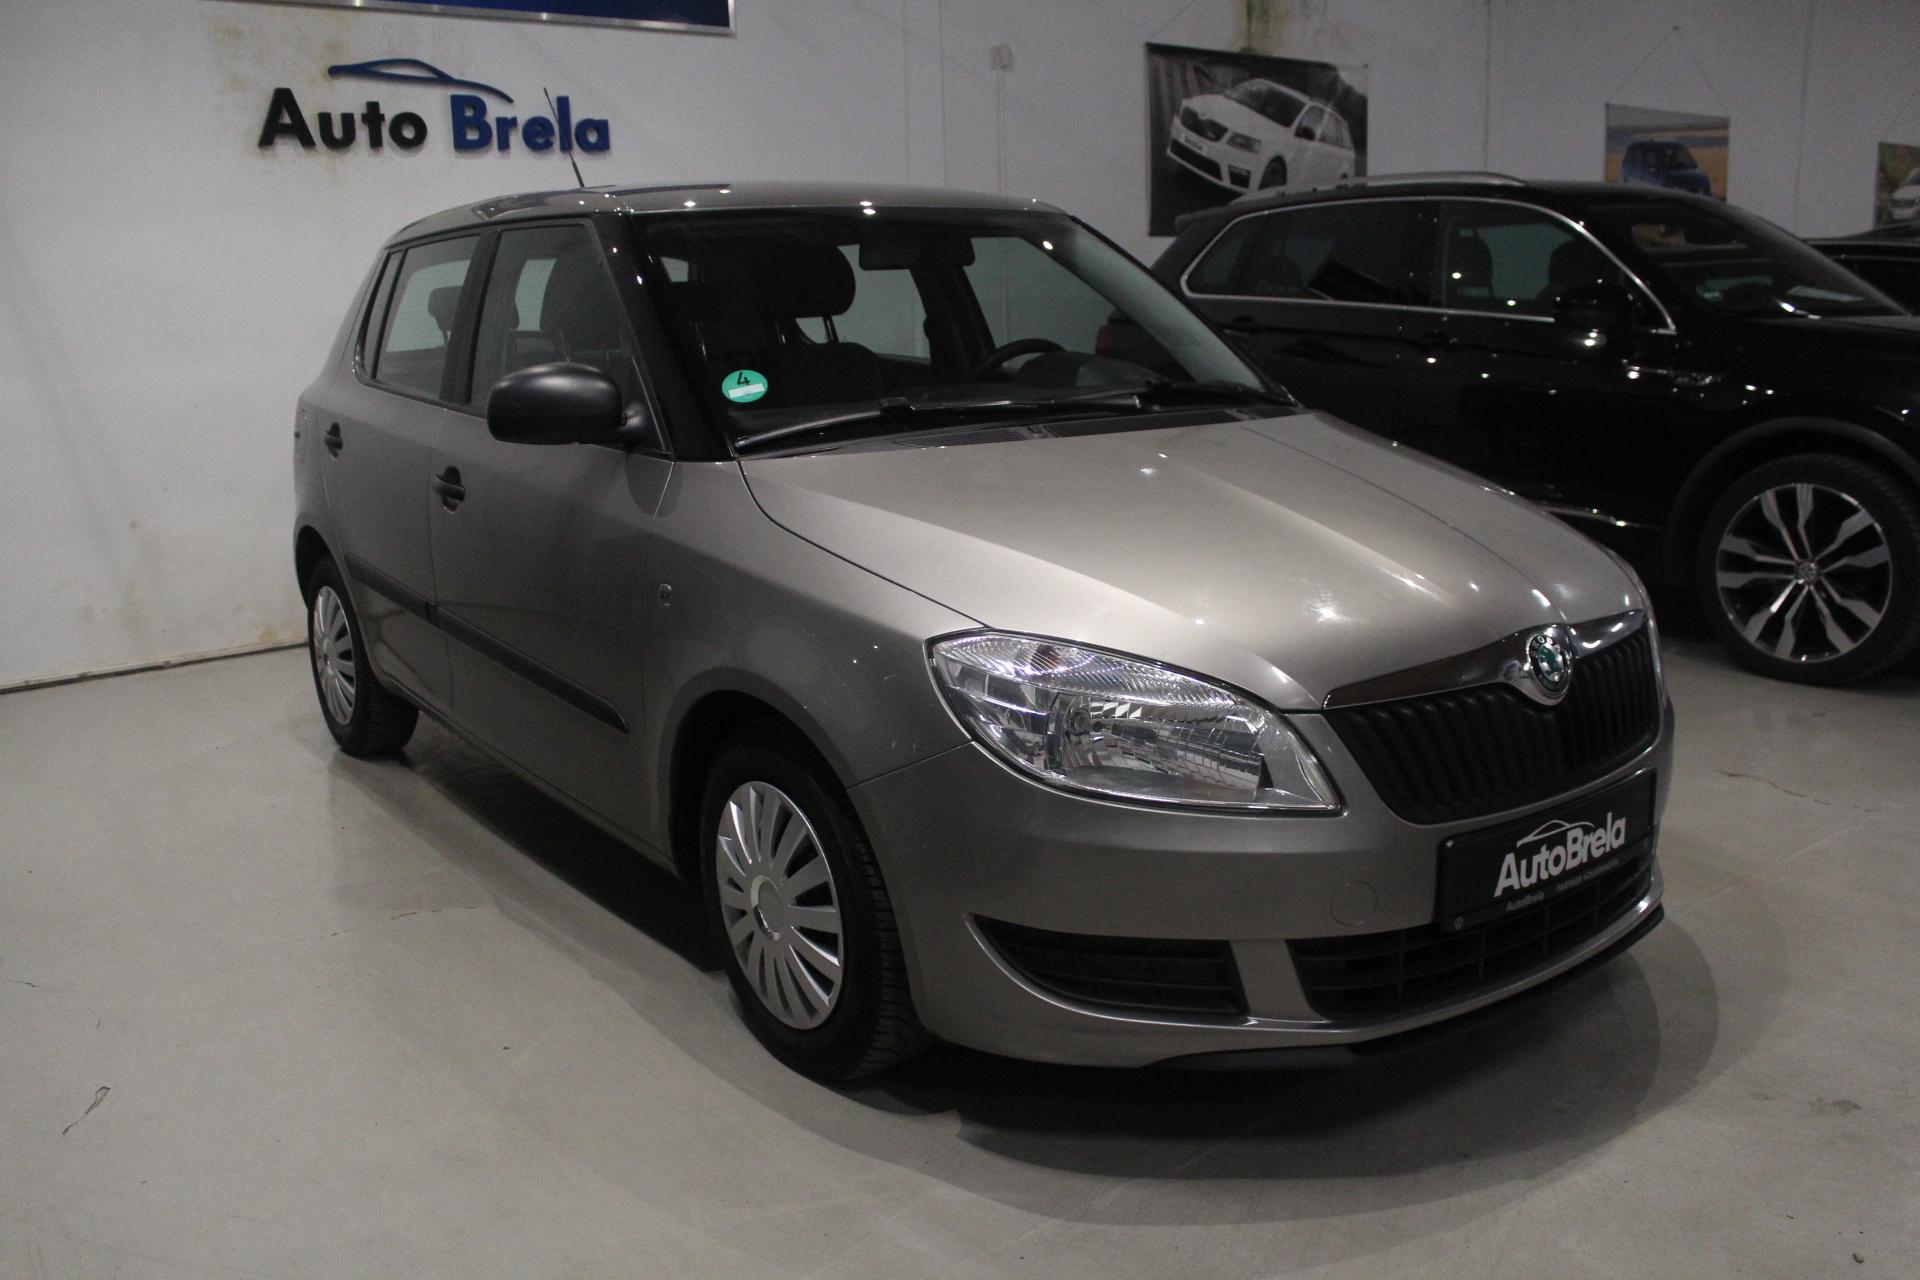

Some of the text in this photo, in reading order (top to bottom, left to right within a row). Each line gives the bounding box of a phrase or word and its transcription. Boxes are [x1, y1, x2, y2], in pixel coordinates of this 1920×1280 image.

[257, 87, 610, 152] Auto Brela
[737, 372, 750, 385] 4
[1494, 812, 1626, 897] AutoBrela
